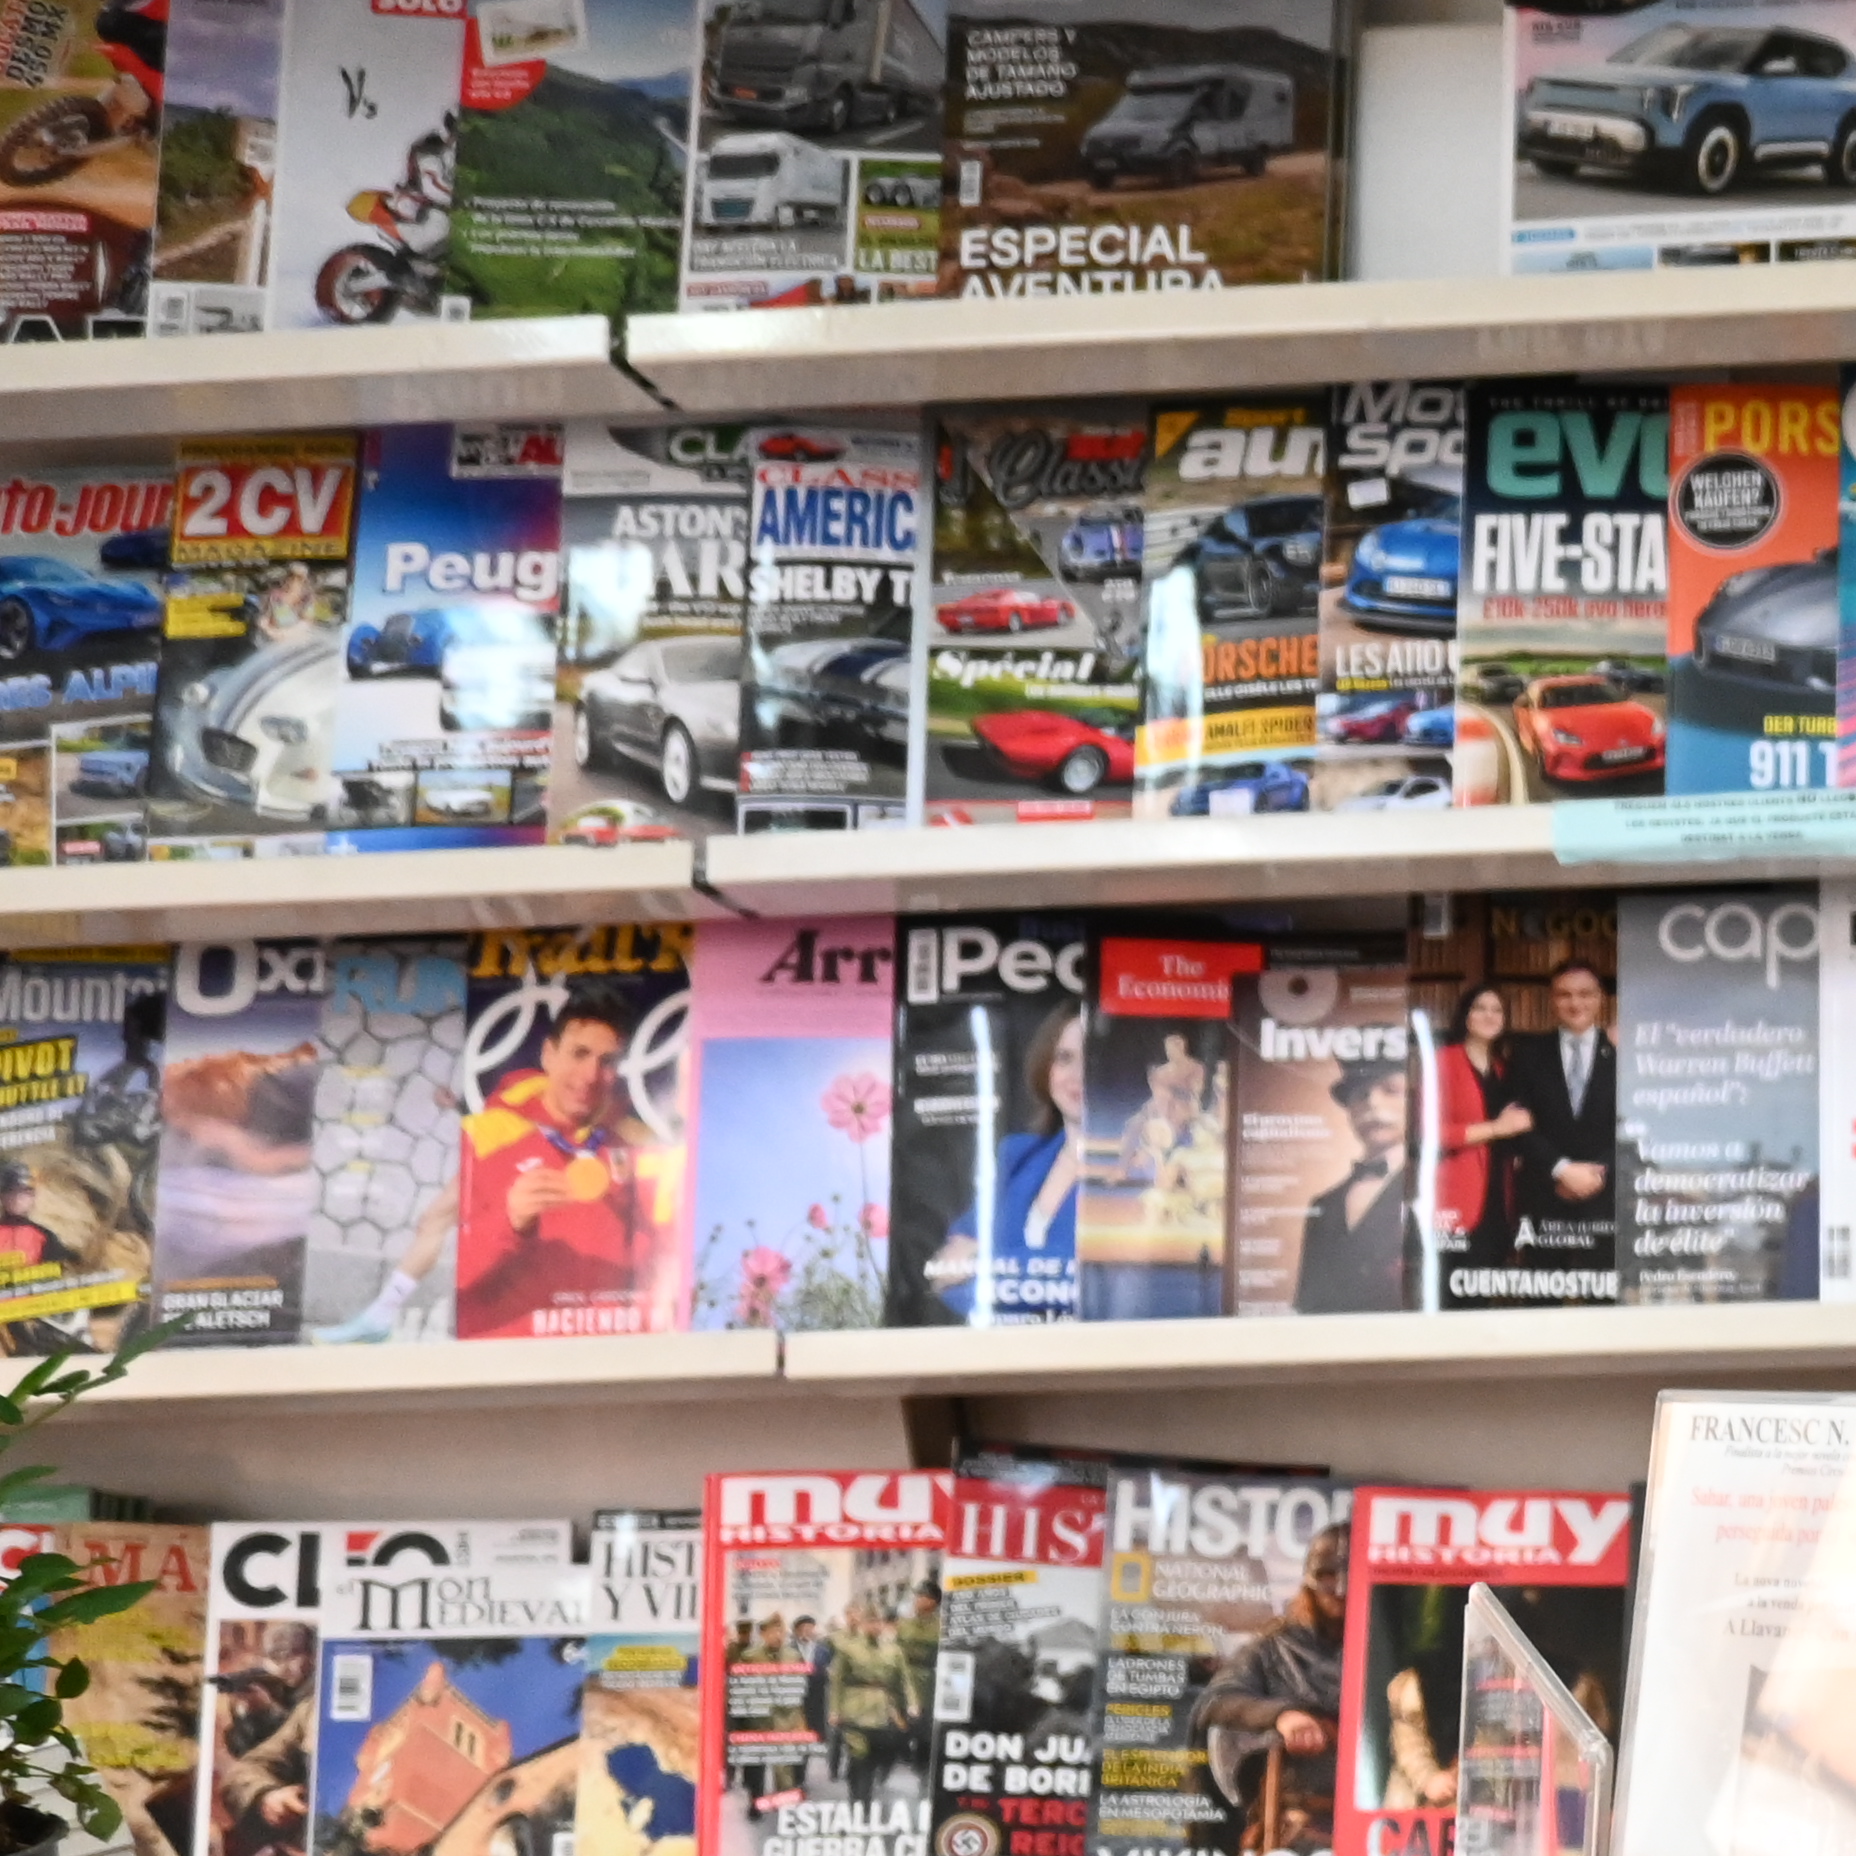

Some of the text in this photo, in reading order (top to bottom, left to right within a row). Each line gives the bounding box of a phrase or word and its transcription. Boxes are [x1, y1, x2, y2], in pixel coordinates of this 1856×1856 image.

[959, 224, 1206, 269] ESPECIAL
[1704, 402, 1839, 457] PORS
[184, 466, 344, 537] 2CV
[1473, 513, 1666, 593] FIVE-STA
[384, 541, 558, 602] Peug
[750, 566, 870, 603] SHELBY
[1337, 643, 1380, 677] LES
[1749, 742, 1812, 788] 911
[1161, 953, 1205, 975] The
[1634, 1167, 1811, 1196] democratizar
[1635, 1199, 1661, 1226] la
[1690, 1415, 1850, 1446] FRANCESC N.
[721, 1523, 943, 1546] HISTORIA
[1368, 1496, 1631, 1567] muy
[1367, 1543, 1558, 1566] HISTORIA
[952, 1572, 1026, 1587] DOSSIER
[1154, 1563, 1249, 1583] NATIONAL
[1107, 1671, 1185, 1684] DE TUMBAS
[1108, 1658, 1185, 1672] LADRONES
[1107, 1683, 1180, 1696] EN EGIPTO
[945, 1731, 1024, 1761] DON
[943, 1765, 993, 1792] DE
[778, 1802, 916, 1838] ESTALLA
